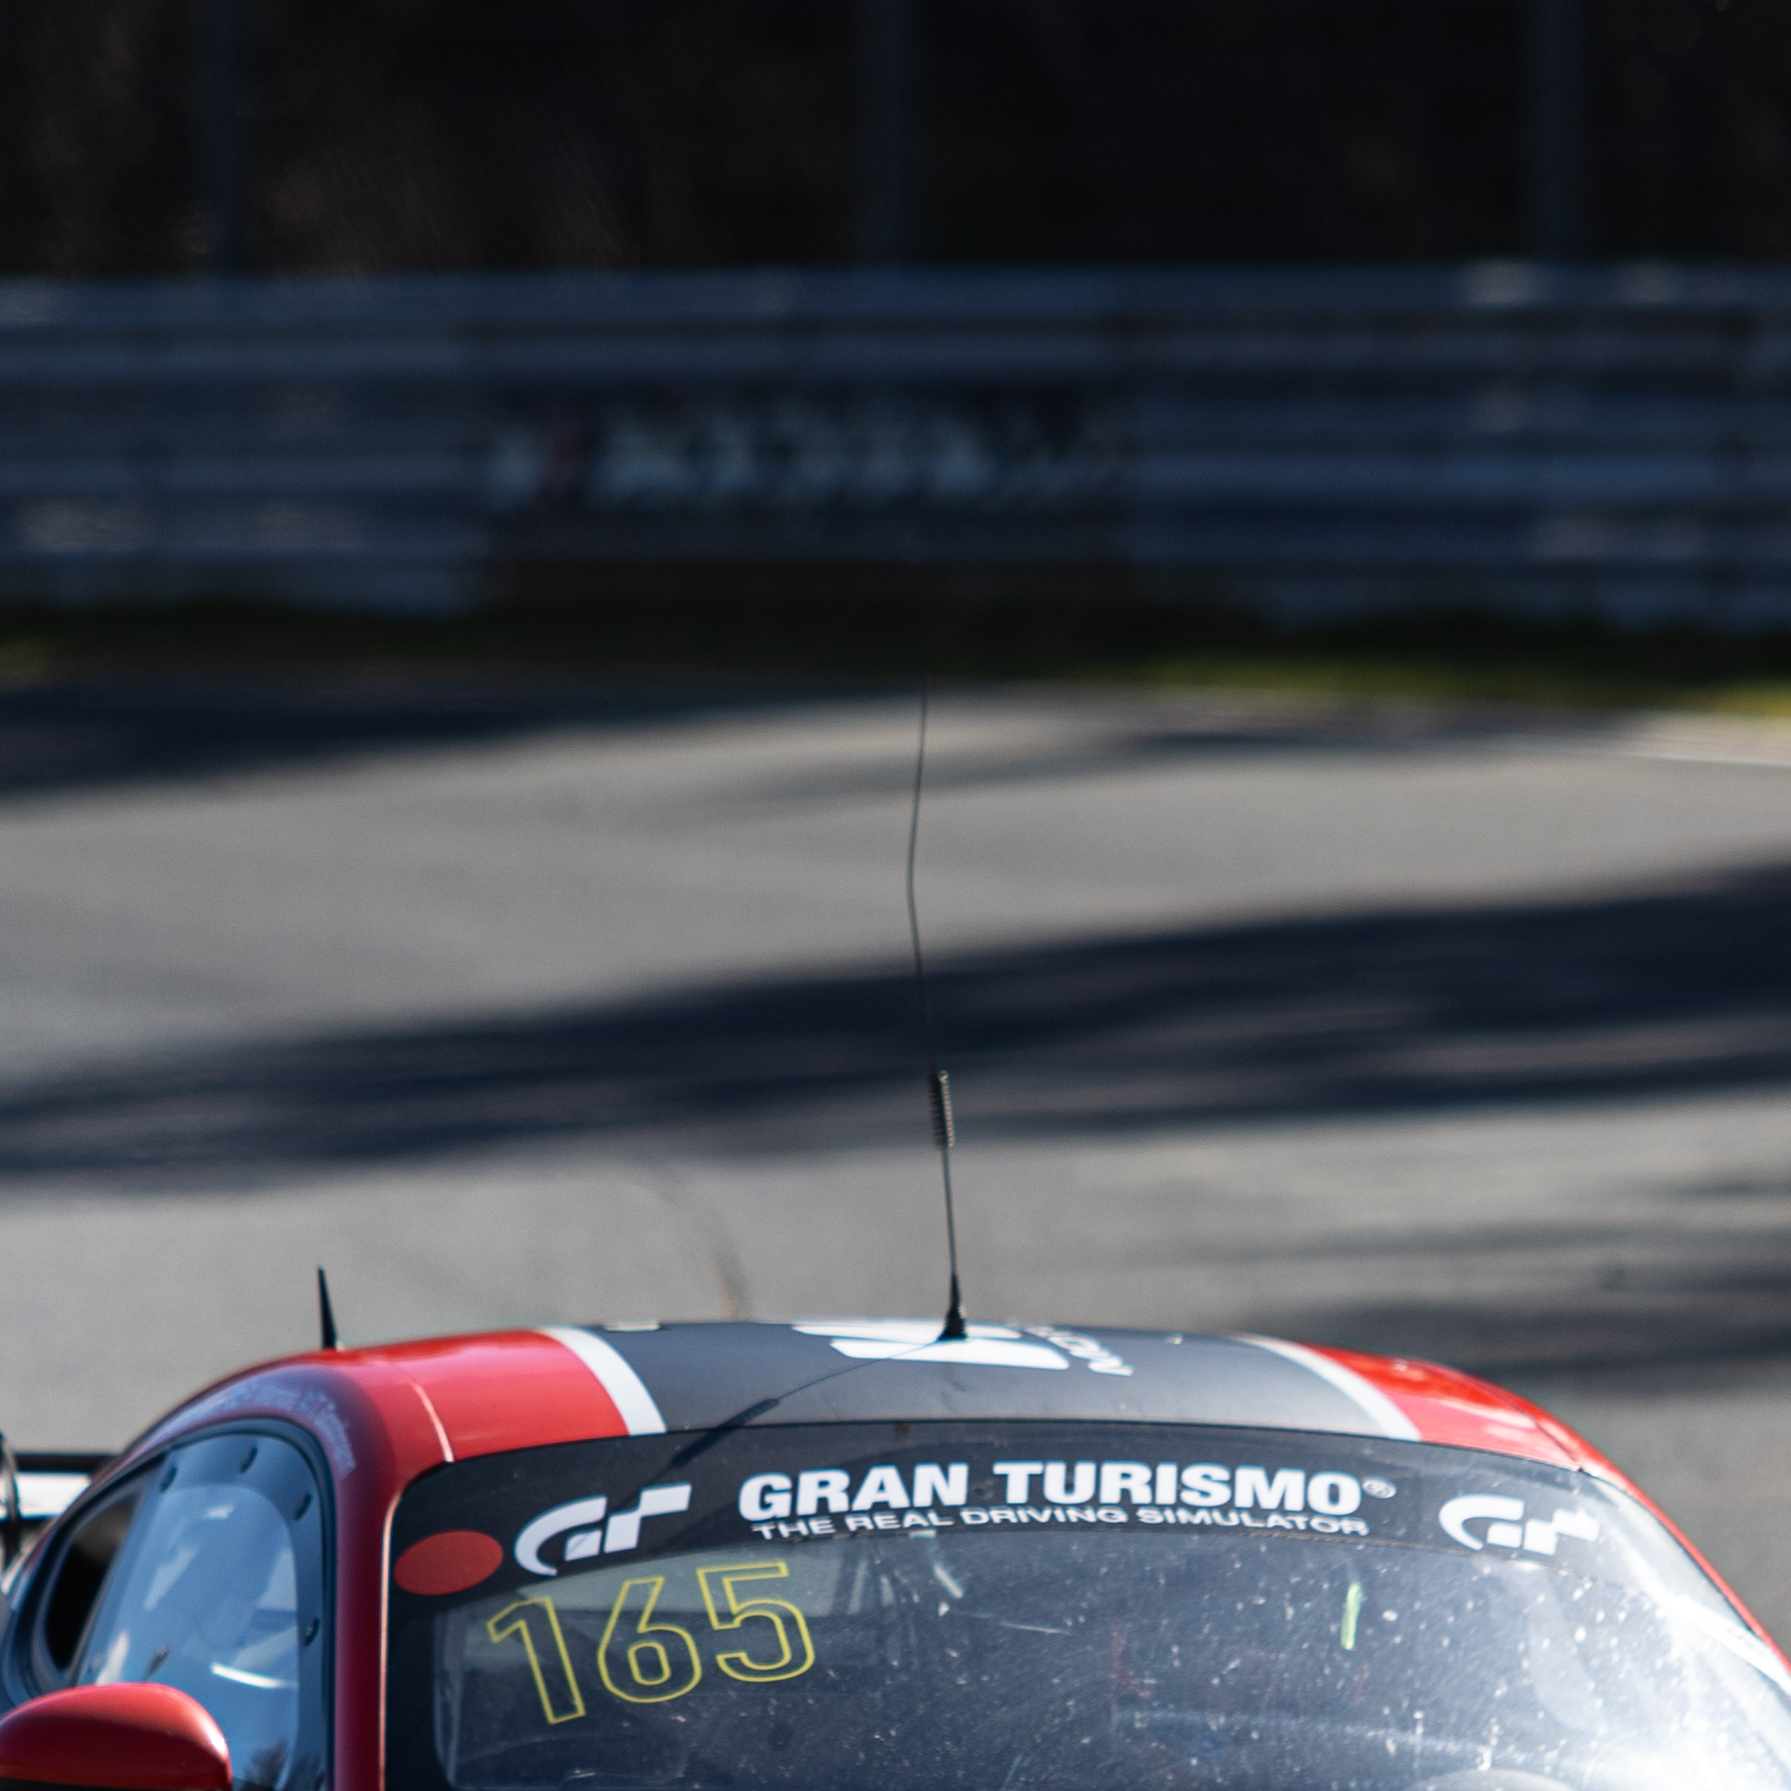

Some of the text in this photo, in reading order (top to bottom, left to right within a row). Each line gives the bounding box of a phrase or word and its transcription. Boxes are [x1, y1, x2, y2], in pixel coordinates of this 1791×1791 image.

[738, 1462, 969, 1522] GRAN
[753, 1506, 1370, 1540] THE REAL DRIVING SIMULATOR
[487, 1561, 815, 1725] 165
